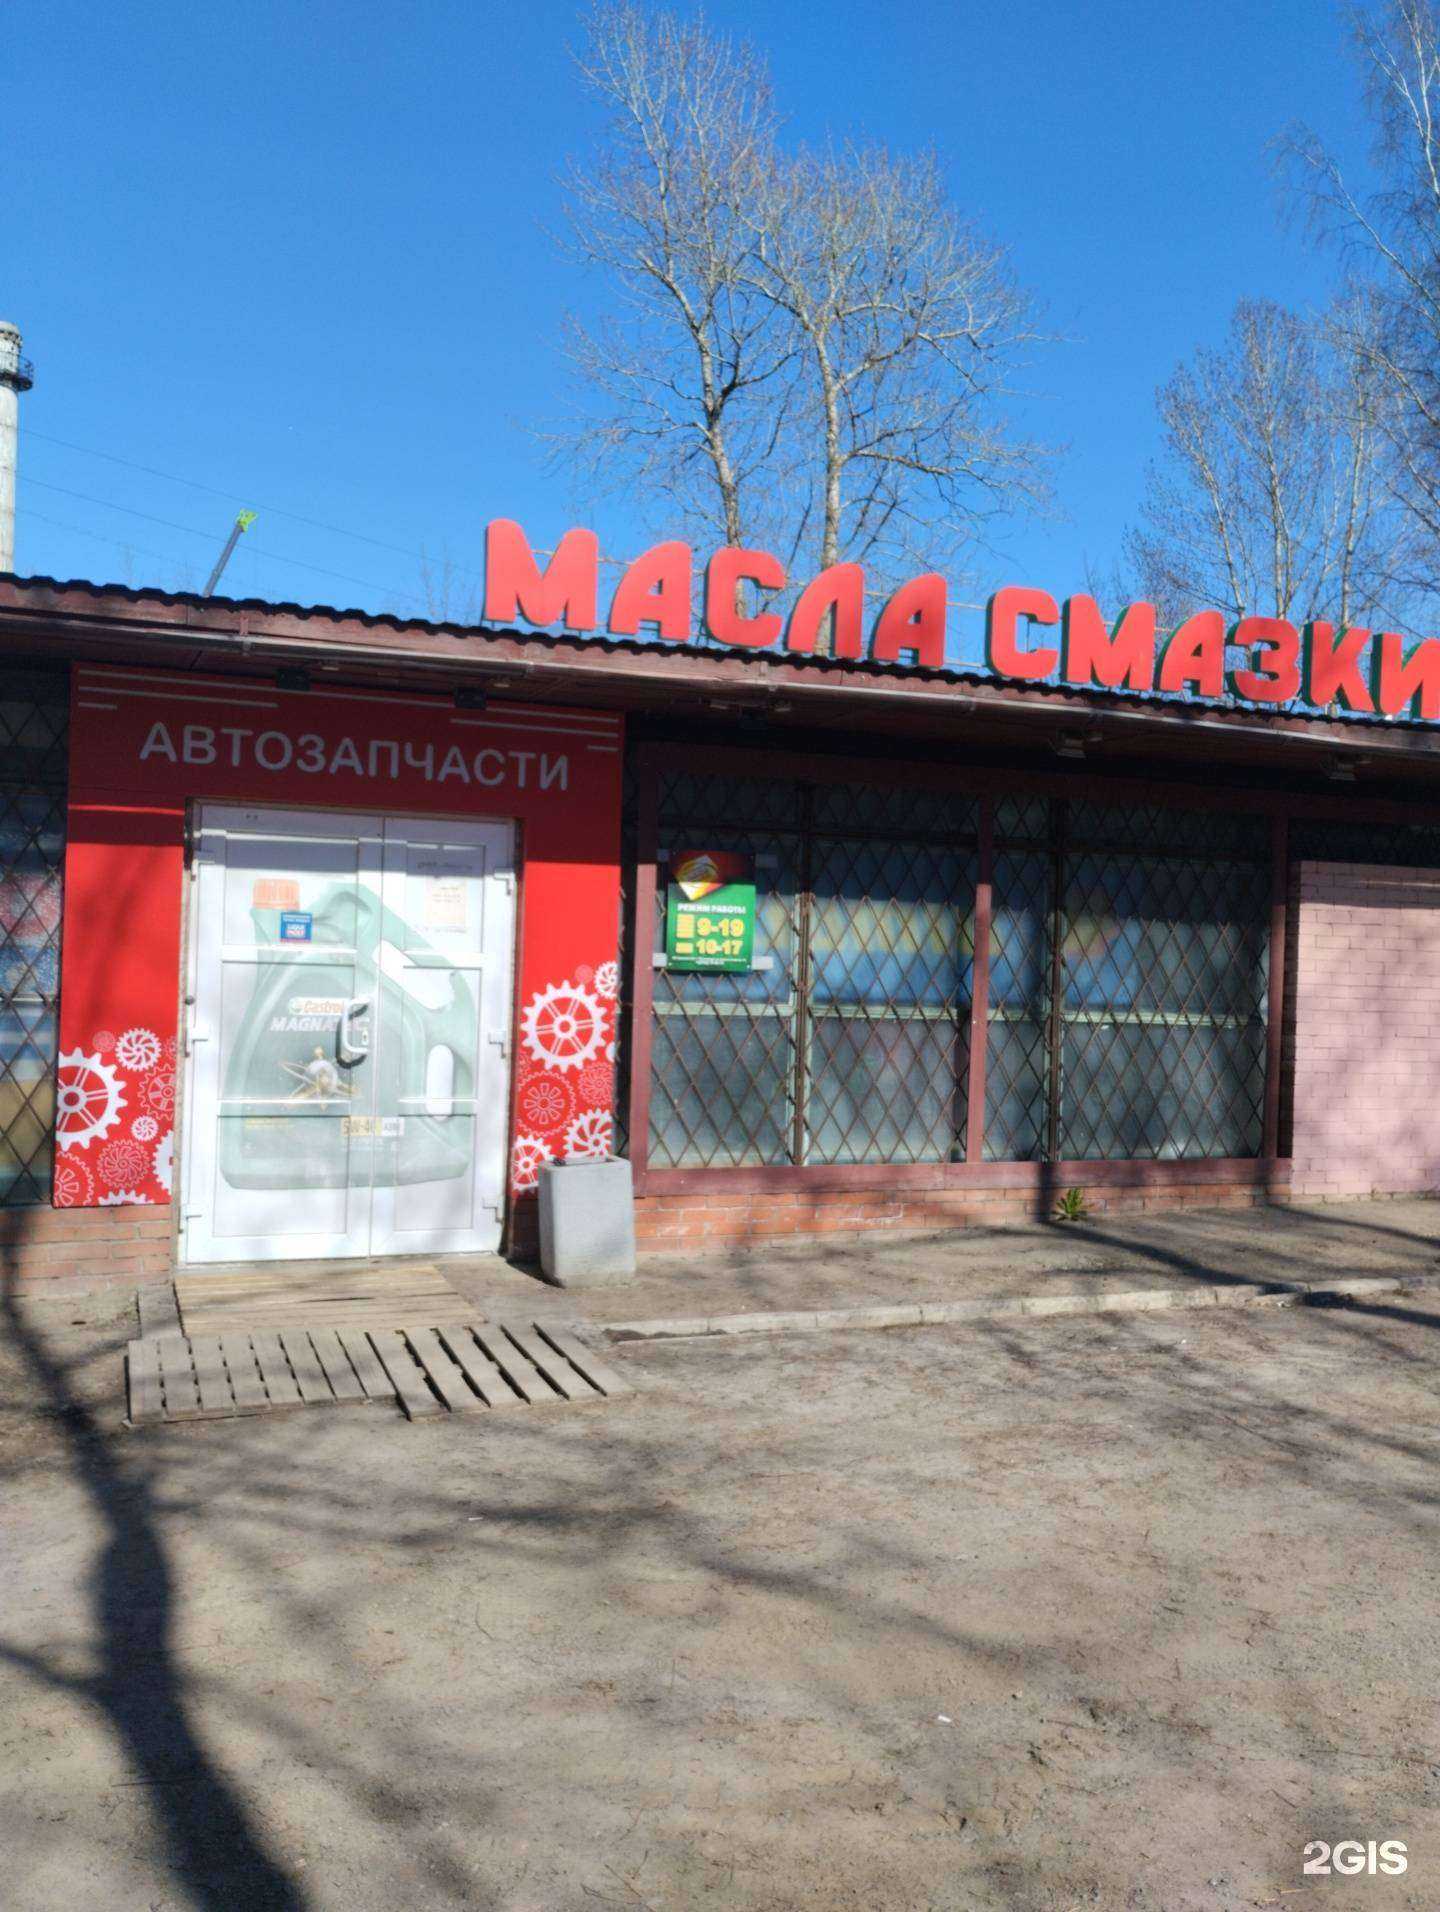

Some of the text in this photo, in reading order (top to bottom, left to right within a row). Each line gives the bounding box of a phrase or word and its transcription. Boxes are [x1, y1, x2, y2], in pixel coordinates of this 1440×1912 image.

[484, 518, 1440, 720] МАСЛА СМАЗКИ
[139, 721, 569, 791] АВТОЗАПЧАСТИ
